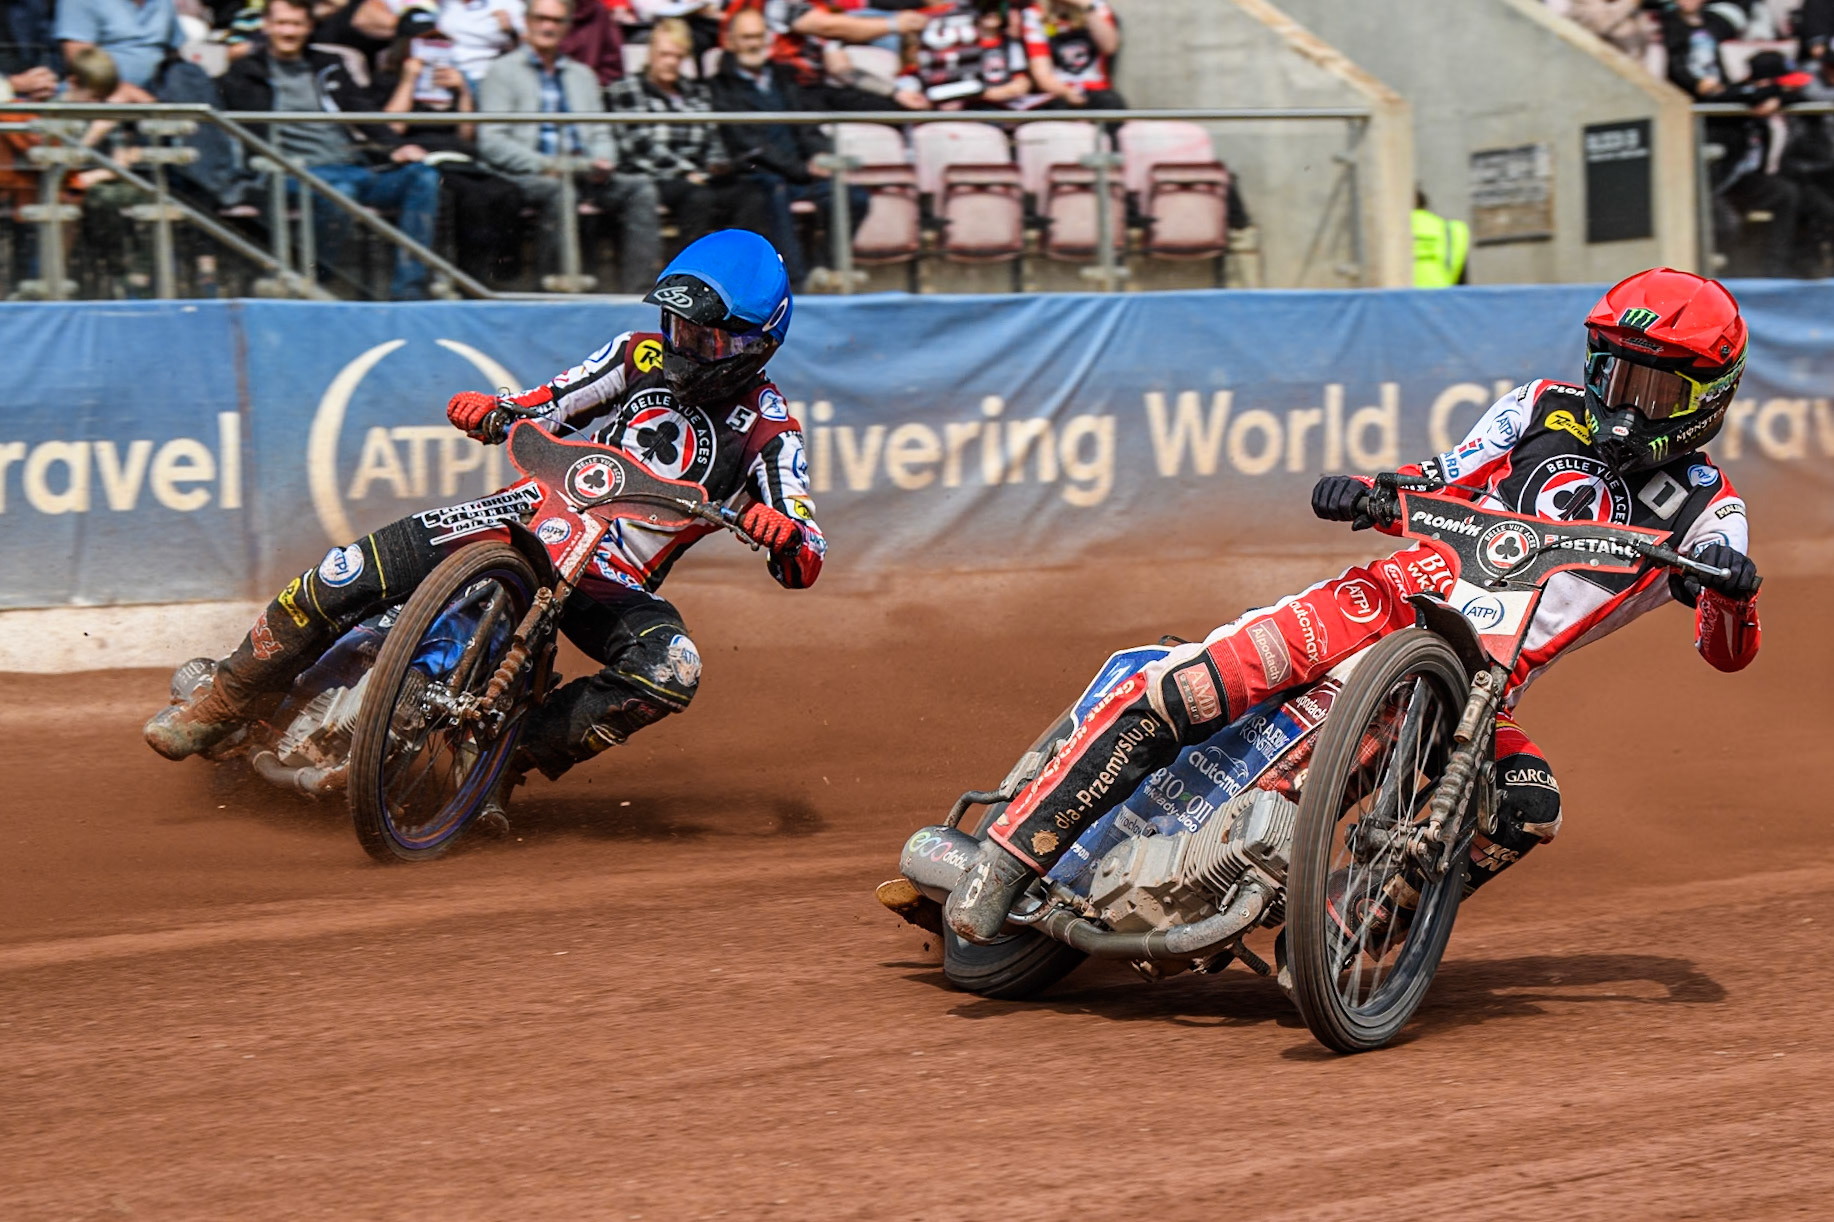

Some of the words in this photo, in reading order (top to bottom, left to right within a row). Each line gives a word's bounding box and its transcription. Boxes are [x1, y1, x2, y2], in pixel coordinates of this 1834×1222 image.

[629, 395, 672, 413] BELLE
[678, 404, 702, 424] VUE
[697, 429, 711, 465] ACES
[729, 408, 752, 429] 5
[1145, 382, 1400, 477] World
[1546, 459, 1590, 473] BELLE
[1596, 466, 1620, 489] VUE
[1411, 511, 1484, 537] PLOMYK
[1346, 585, 1372, 615] ATPI
[1466, 606, 1498, 620] ATPI
[1252, 628, 1280, 681] Alpodach
[1187, 671, 1218, 719] AMD
